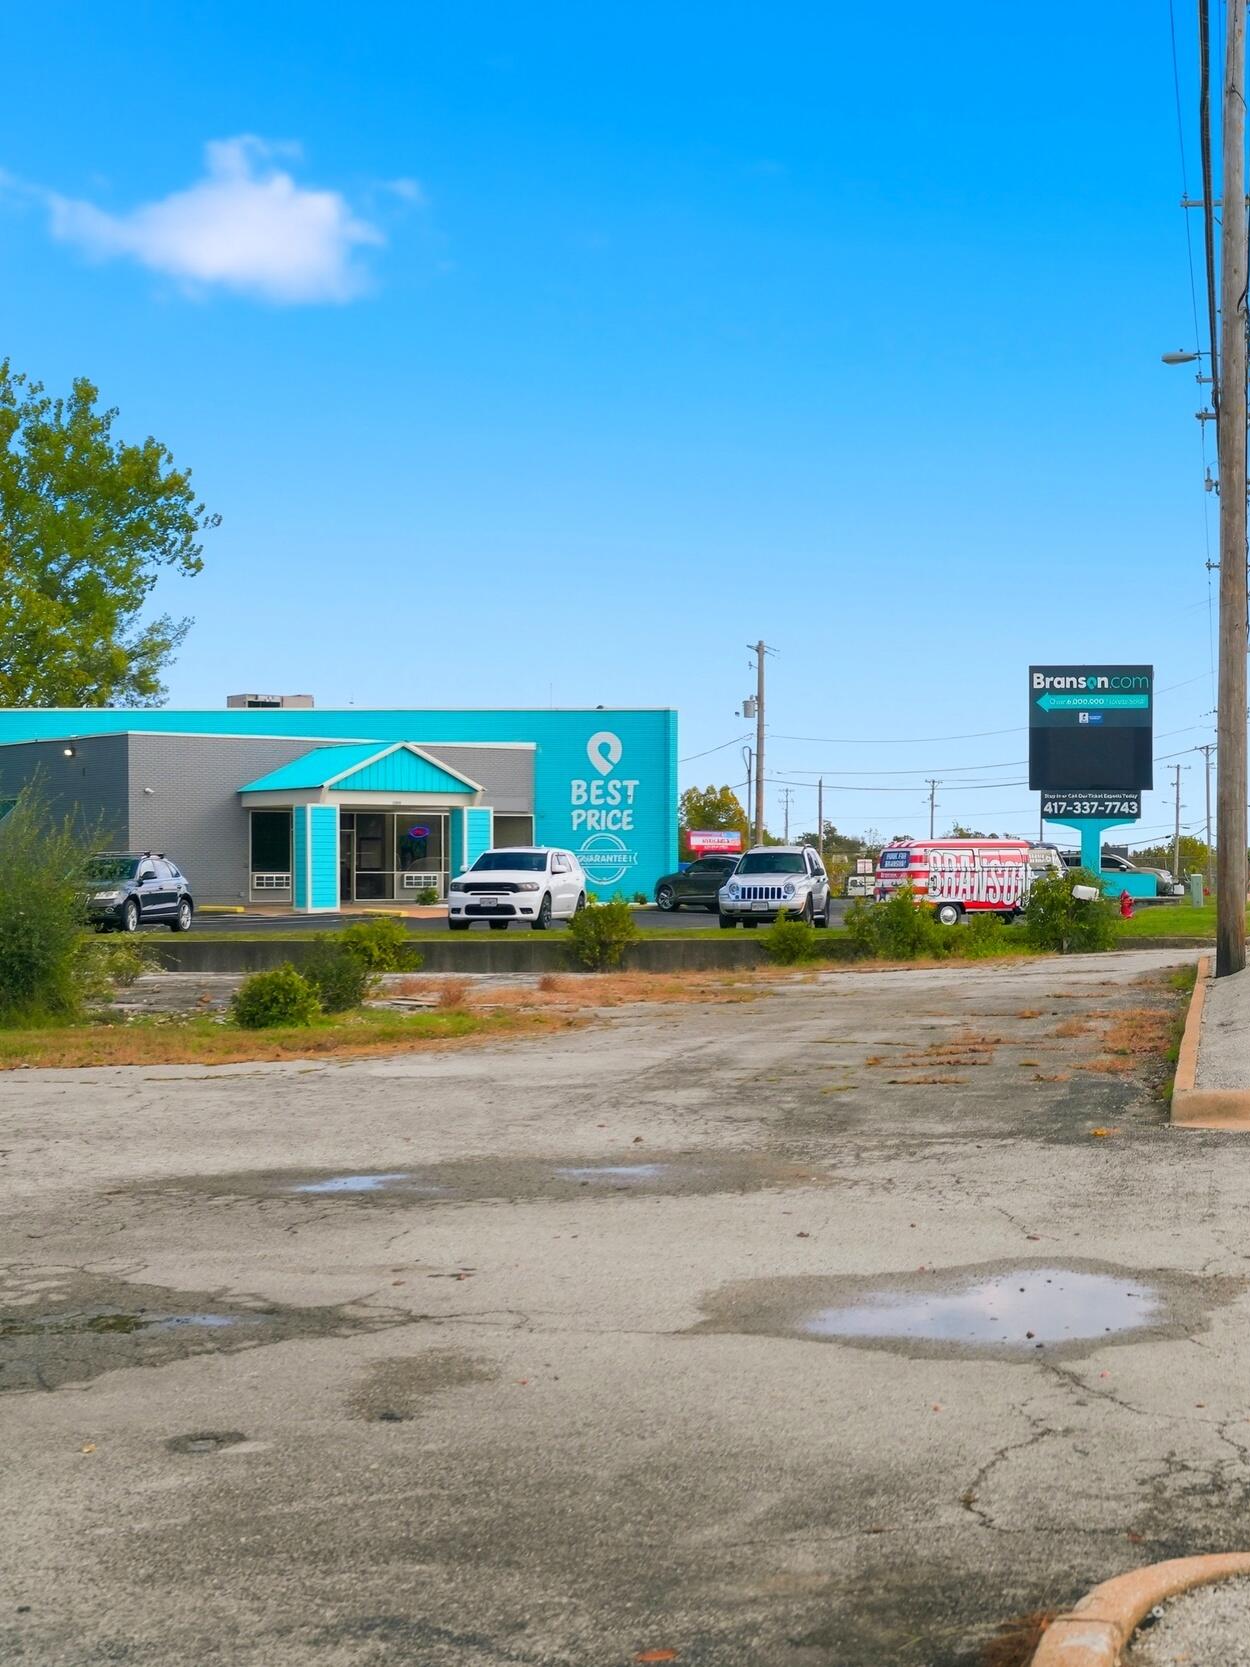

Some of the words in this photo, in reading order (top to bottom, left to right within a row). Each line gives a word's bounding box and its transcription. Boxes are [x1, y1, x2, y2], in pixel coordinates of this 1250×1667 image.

[1032, 672, 1149, 690] Branson.com
[570, 779, 640, 806] BEST
[1043, 801, 1138, 814] 417-337-7743
[571, 809, 635, 832] PRICE
